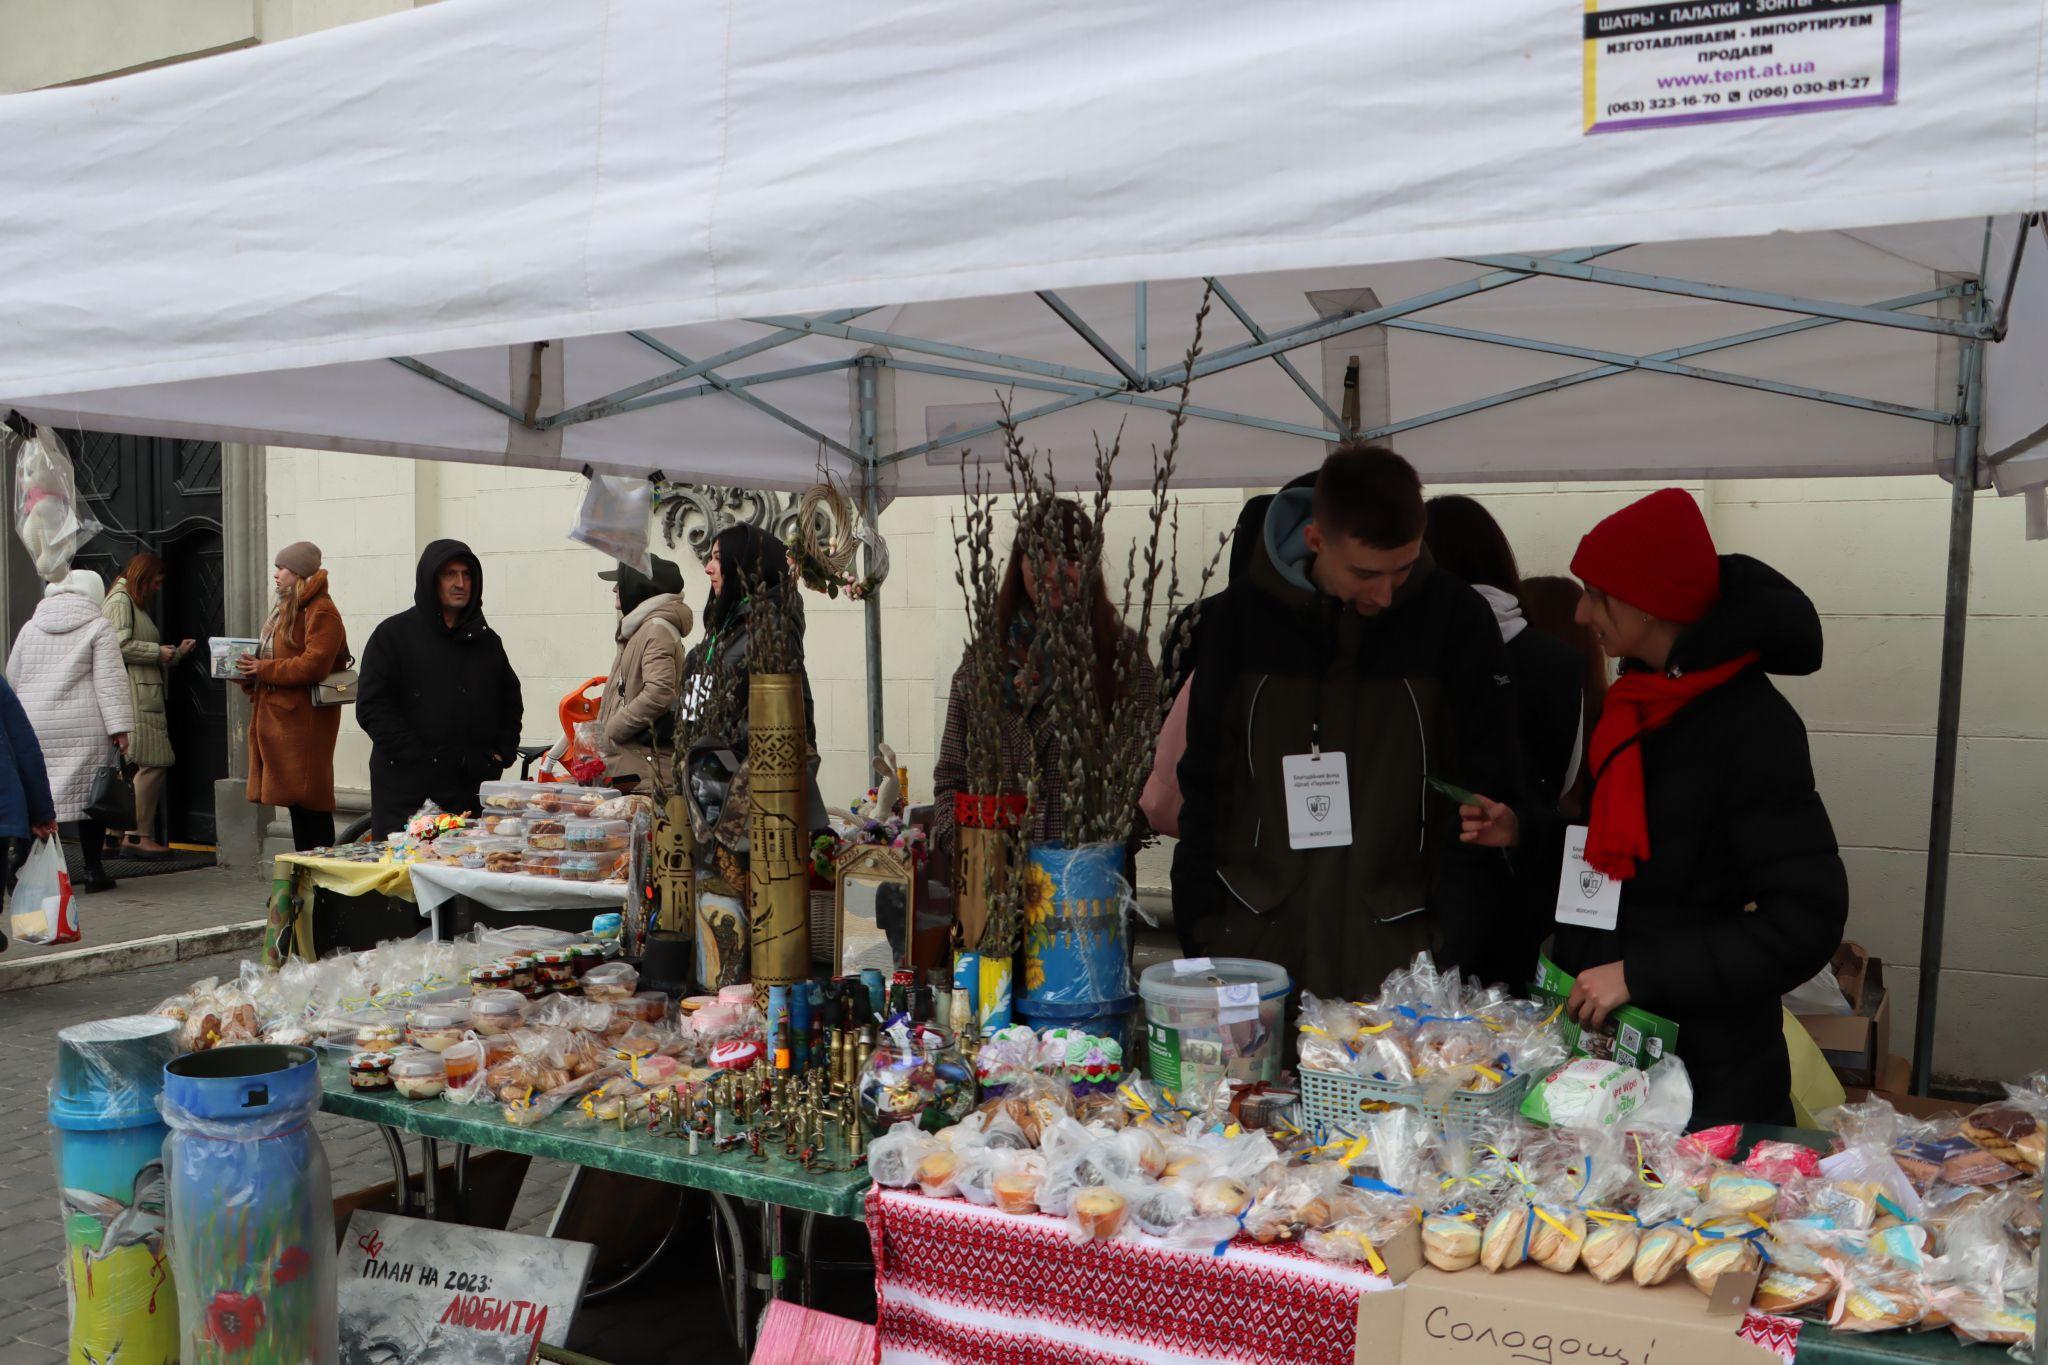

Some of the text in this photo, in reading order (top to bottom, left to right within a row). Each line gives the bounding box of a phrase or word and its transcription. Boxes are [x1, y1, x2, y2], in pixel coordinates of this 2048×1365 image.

[1599, 10, 1654, 31] ШАТРЫ
[1670, 3, 1740, 24] ПАЛАТКИ
[1607, 14, 1873, 54] ИЗГОТАВЛИВАЕМ ИМПОРТИРУЕМ
[1698, 44, 1773, 63] ПРОДАЕМ
[1657, 59, 1815, 89] www.tent.at.ua
[1607, 77, 1870, 116] (063) 323-16-70 (096) 030-81-27
[363, 1259, 414, 1283] ПЛАН
[418, 1267, 438, 1287] НА
[439, 1294, 549, 1350] ЛЮБИТИ
